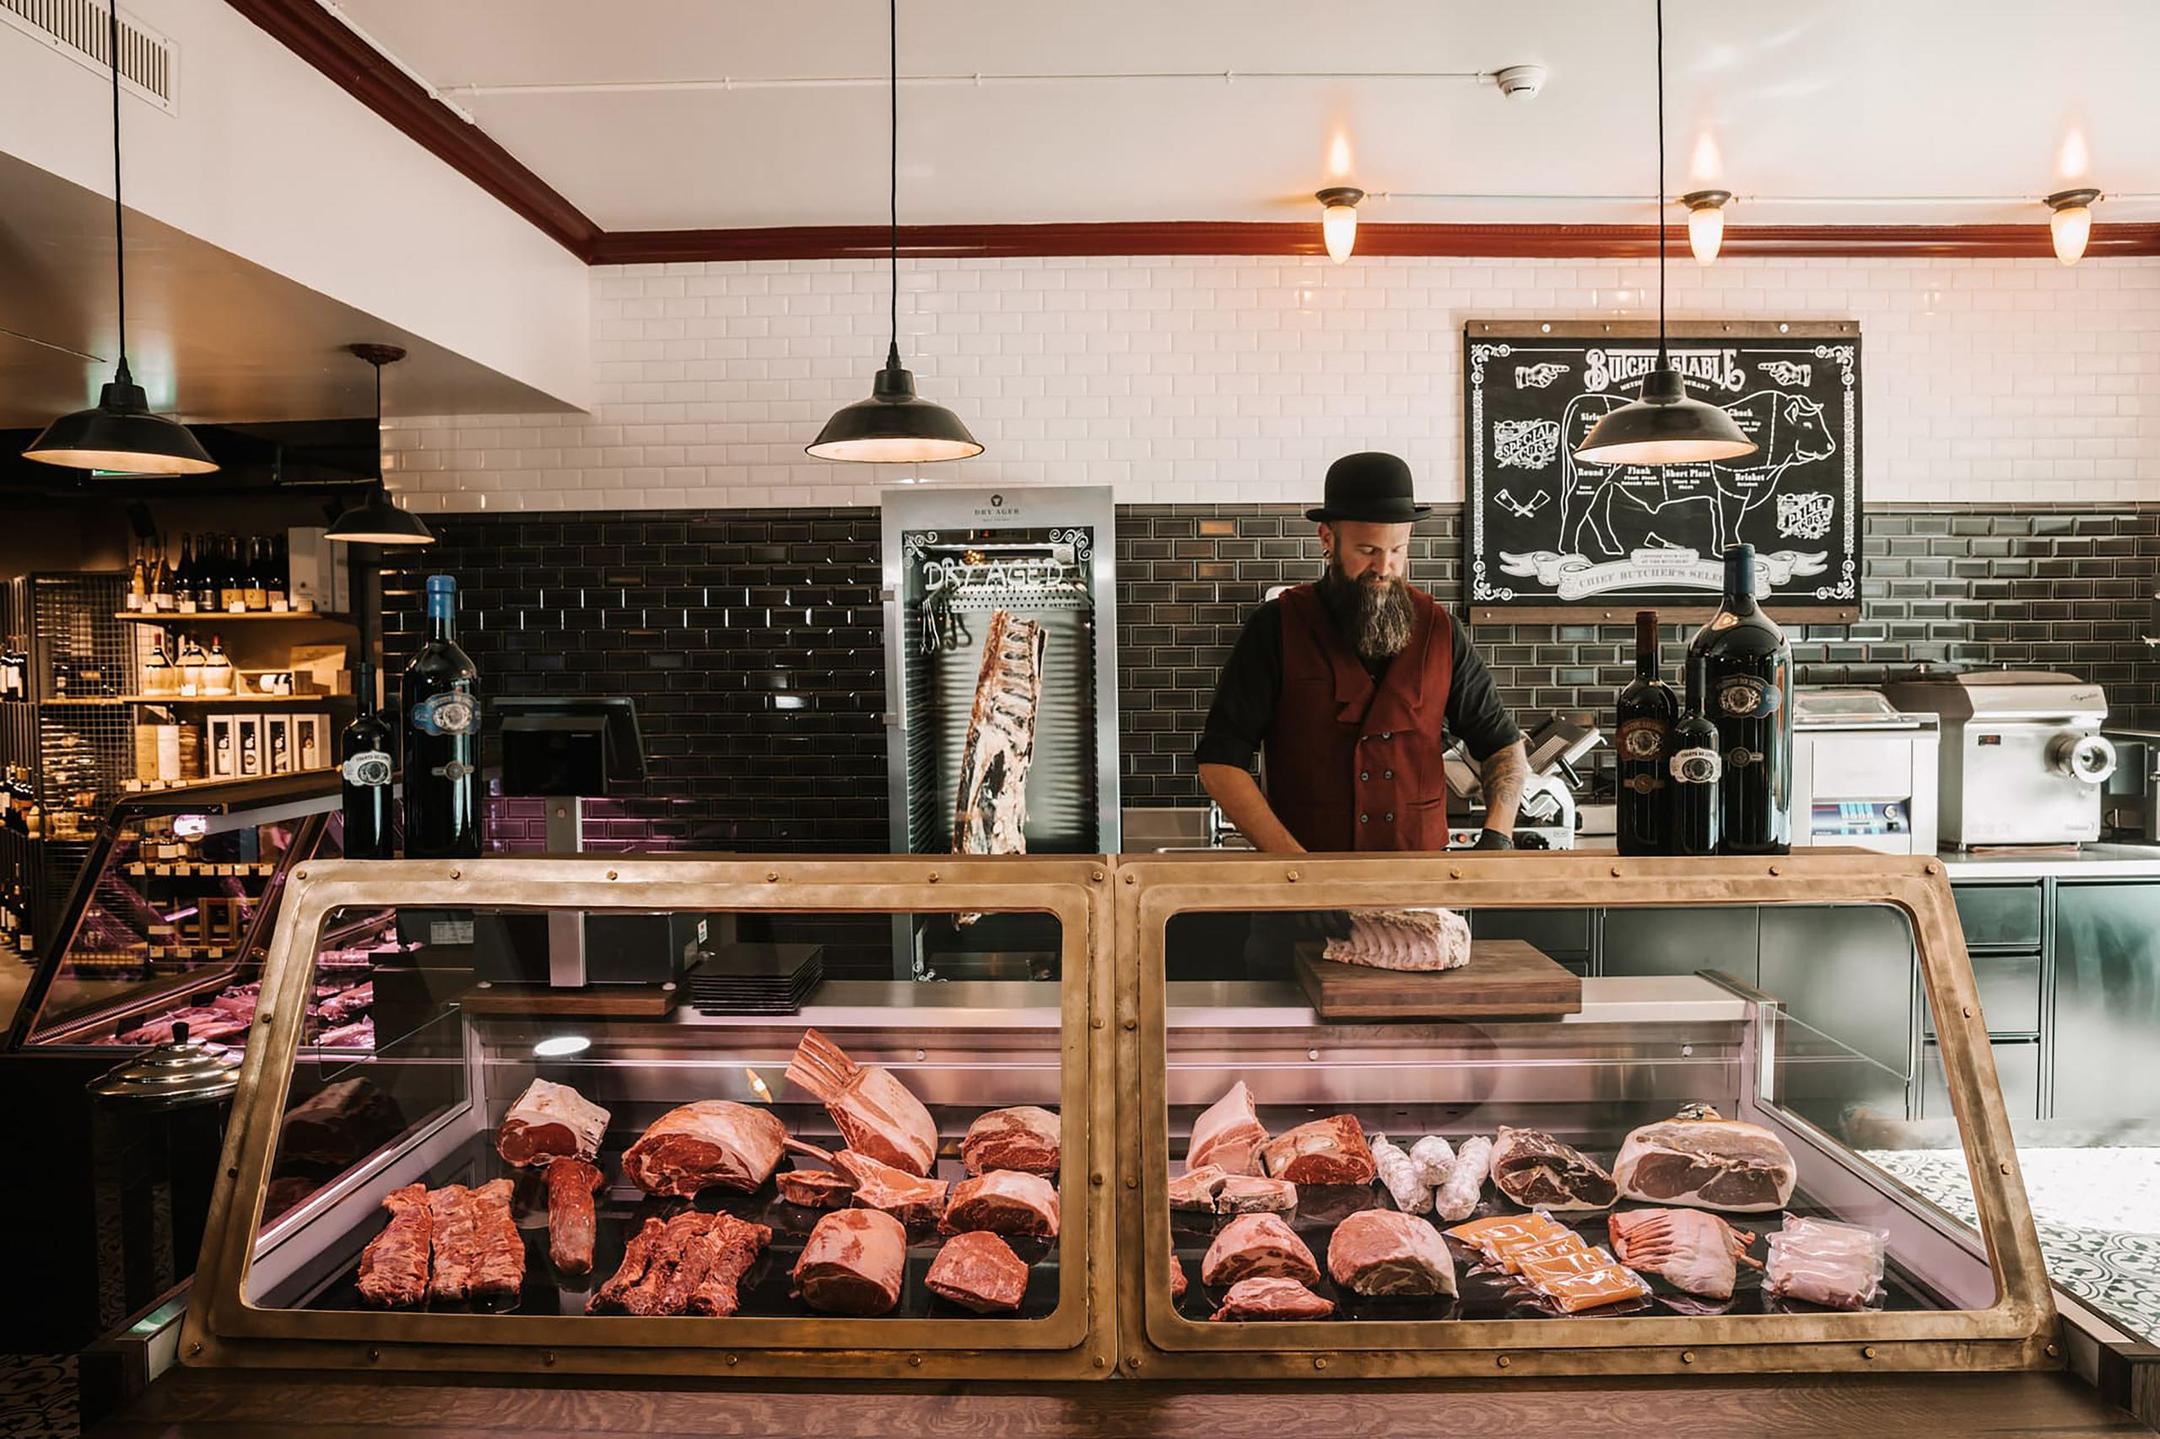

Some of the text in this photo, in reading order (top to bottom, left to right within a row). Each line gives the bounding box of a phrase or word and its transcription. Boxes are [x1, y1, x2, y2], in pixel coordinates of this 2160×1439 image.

[1503, 423, 1554, 457] SPECIAL
[1578, 468, 1604, 477] Round
[1627, 466, 1651, 475] Flank
[1665, 469, 1688, 478] Short
[1689, 469, 1711, 478] Plate
[1735, 473, 1765, 481] Brisket
[923, 557, 1064, 591] DRY AGED
[1620, 568, 1686, 580] BUTCHER'S
